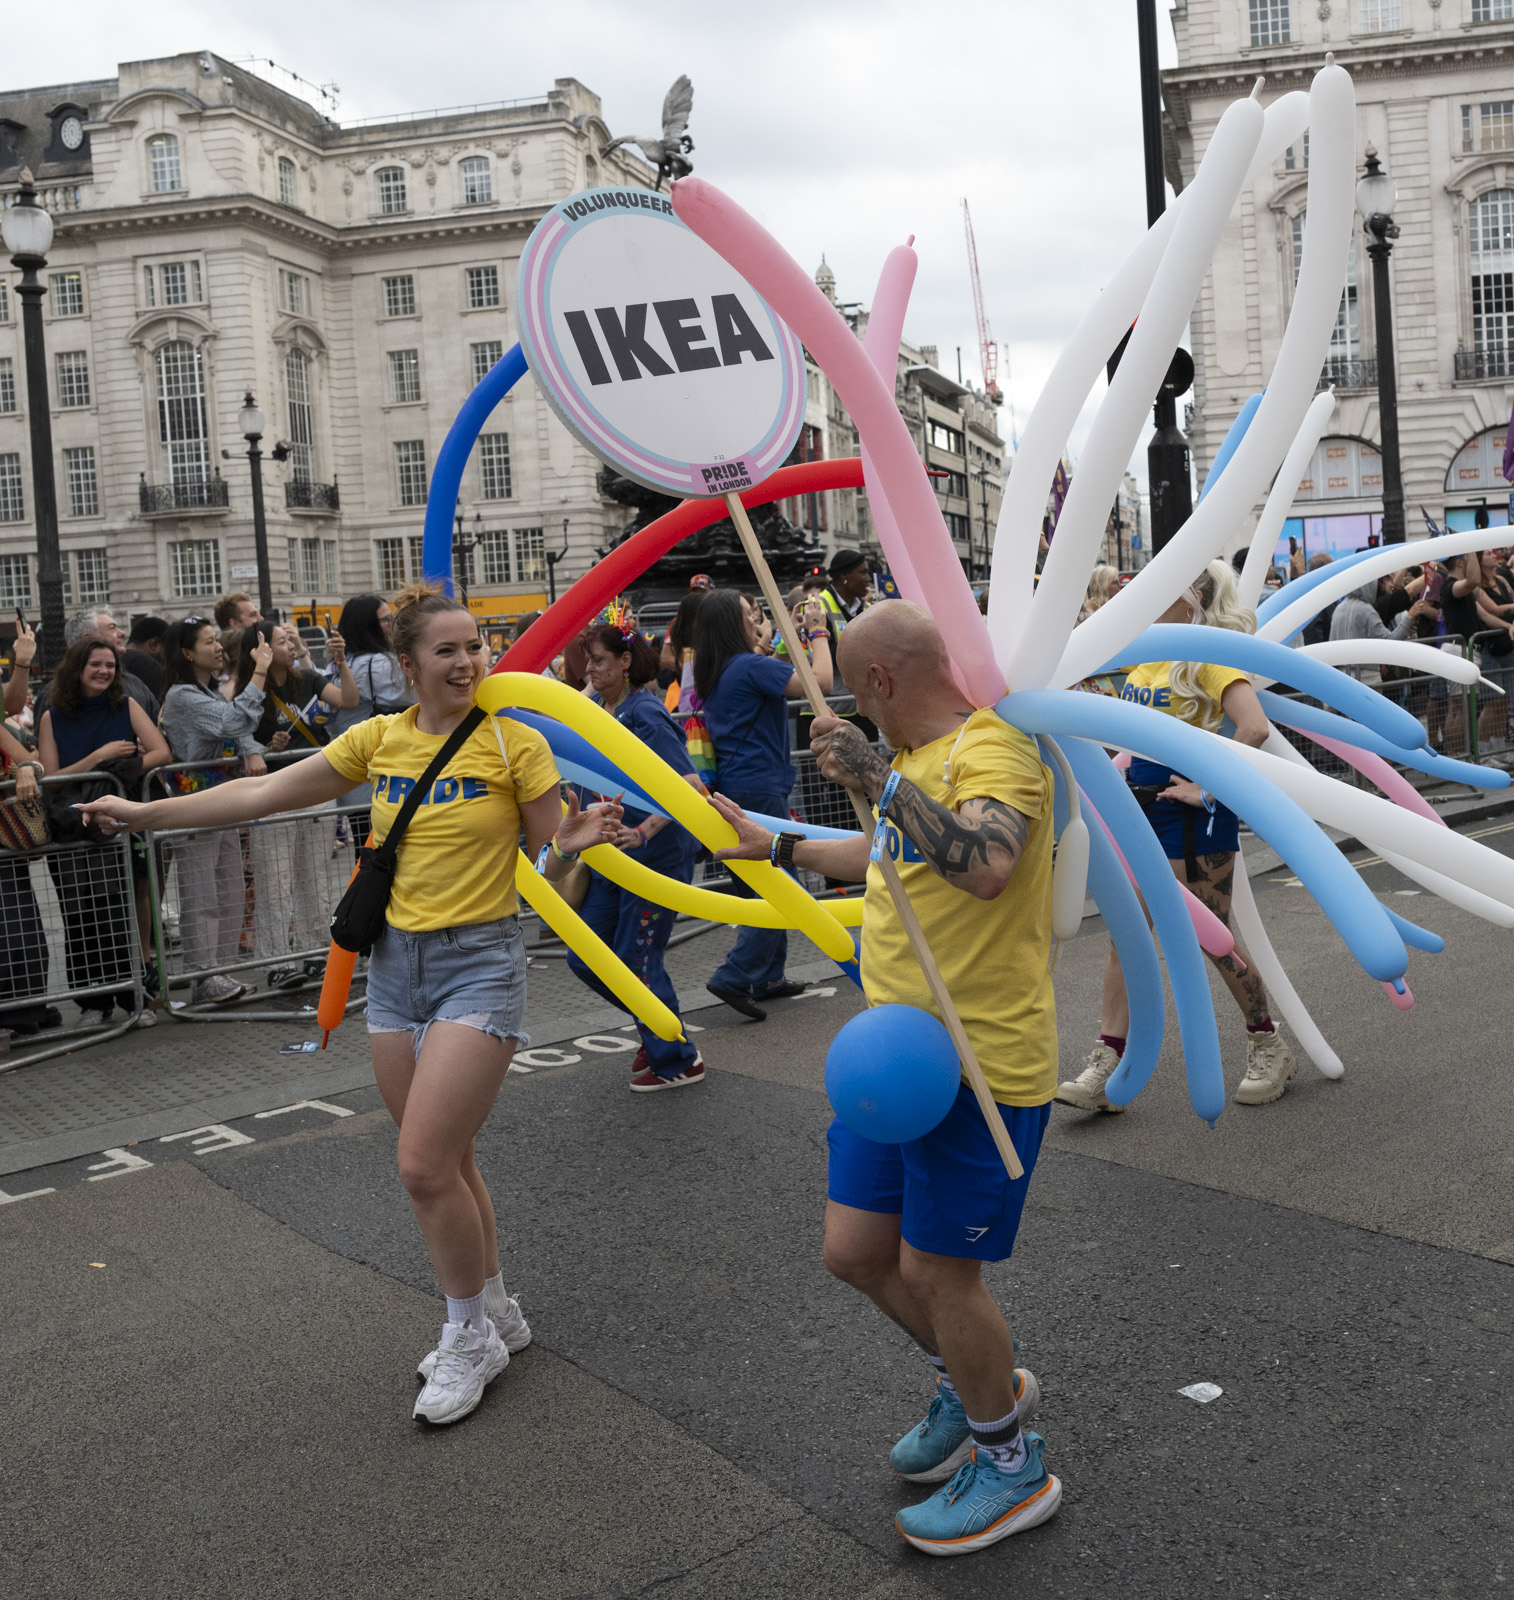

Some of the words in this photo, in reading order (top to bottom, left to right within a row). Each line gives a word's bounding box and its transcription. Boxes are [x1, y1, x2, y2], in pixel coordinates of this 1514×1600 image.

[563, 192, 674, 222] VOLUNQUEER
[563, 293, 775, 386] IKEA
[707, 484, 719, 494] IN
[719, 477, 752, 491] LONDON
[1122, 683, 1171, 707] RIDE
[375, 775, 489, 805] PRDE
